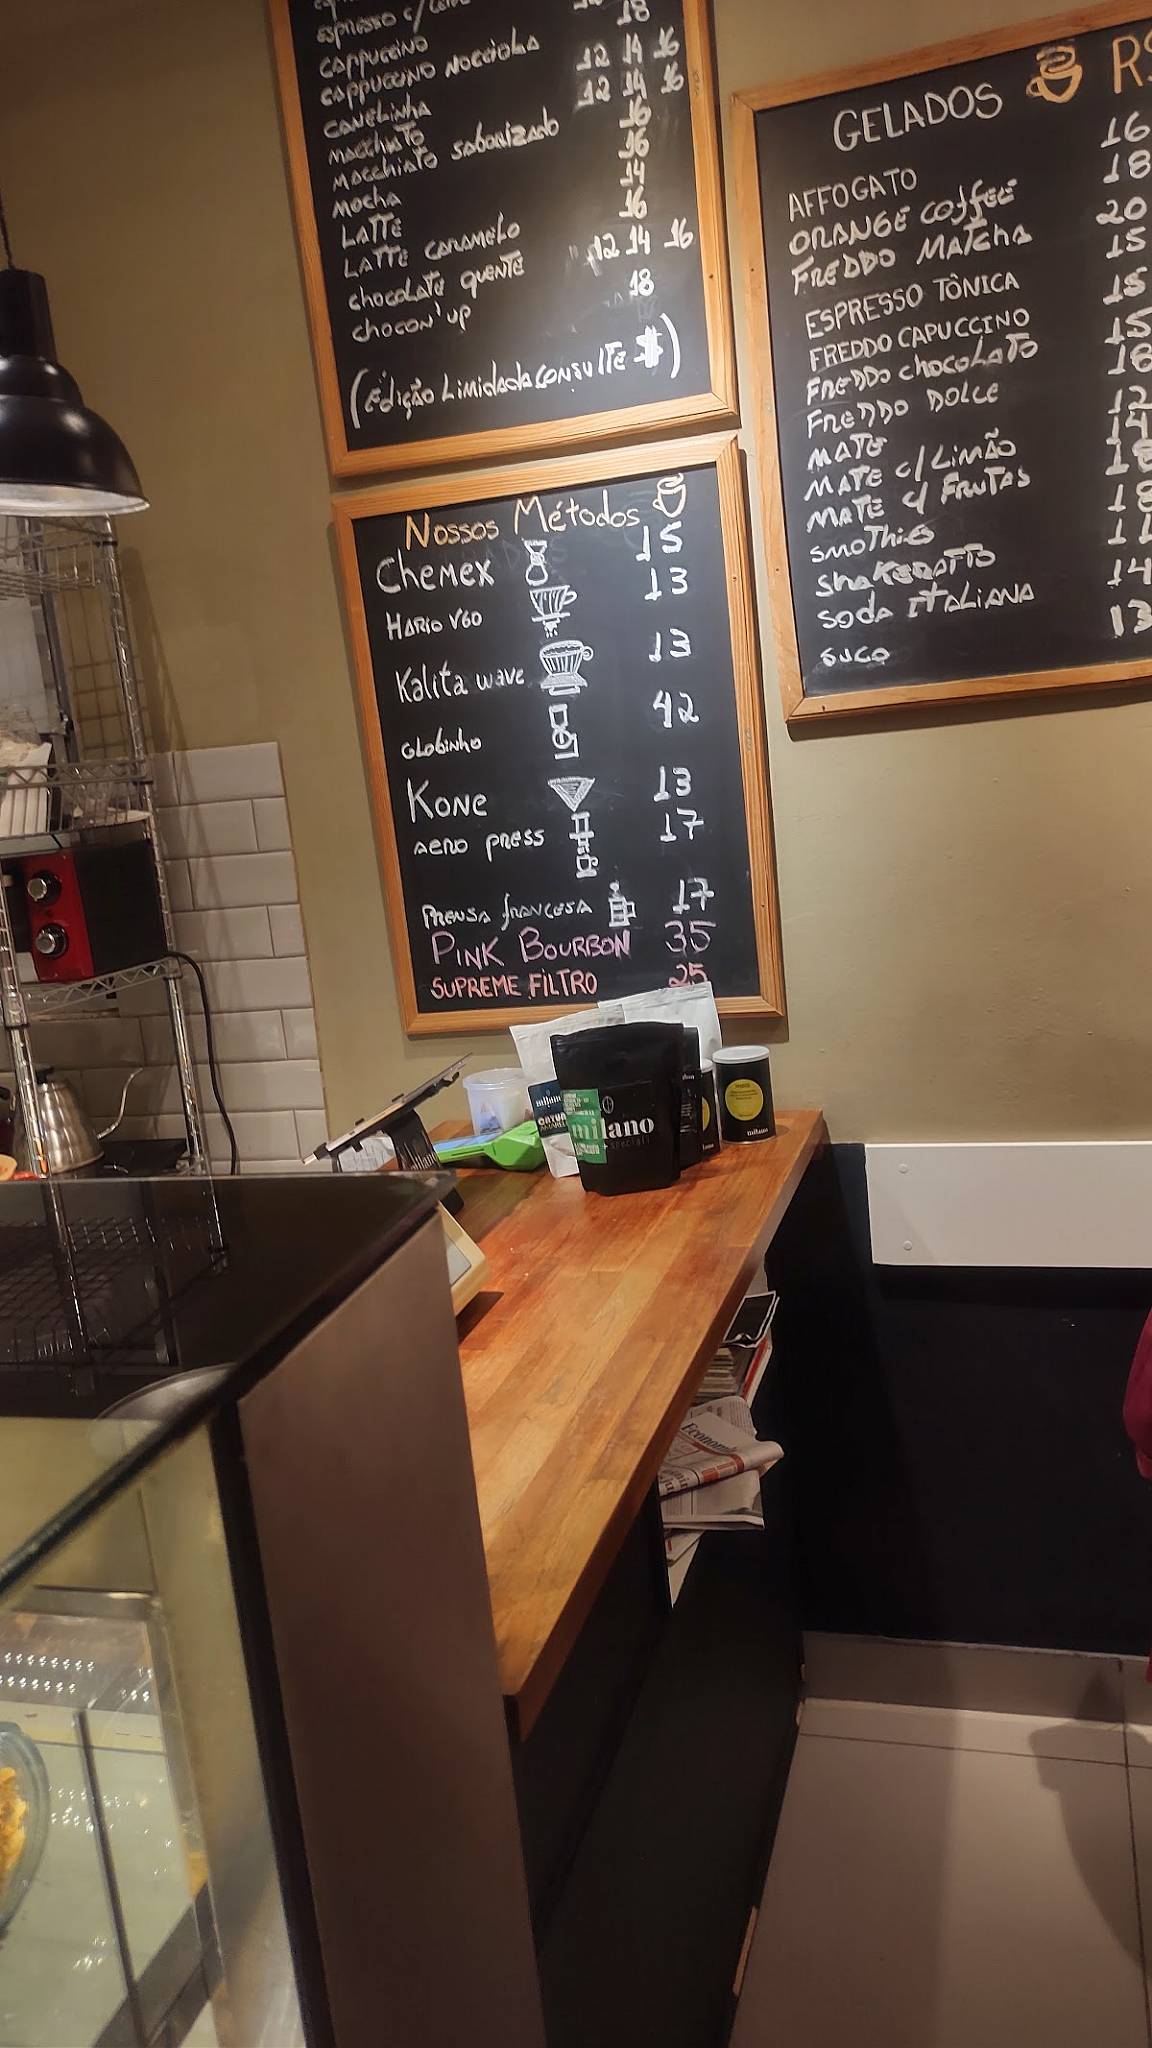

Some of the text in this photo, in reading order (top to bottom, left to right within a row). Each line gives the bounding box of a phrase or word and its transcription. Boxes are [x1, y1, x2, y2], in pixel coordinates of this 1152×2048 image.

[576, 26, 680, 71] 12 14 16
[577, 61, 684, 106] 12 14 16
[619, 96, 651, 128] 16
[833, 82, 1003, 152] GELADOS
[618, 127, 649, 158] 16
[620, 159, 645, 187] 14
[788, 111, 1150, 222] AFFOGATO 16
[1103, 150, 1151, 183] 18
[619, 185, 647, 219] 16
[1096, 196, 1147, 225] 20
[626, 224, 650, 254] 14
[664, 217, 693, 249] 16
[629, 268, 654, 297] 18
[805, 226, 1146, 340] ESPRESSO TÔNICA 15
[809, 266, 1148, 372] FREDDO CAPUCCINO 15
[1104, 306, 1152, 344] 15
[1107, 385, 1152, 415] 12
[803, 464, 883, 501] MATE
[1106, 410, 1149, 445] 14
[514, 489, 641, 535] Métodos
[806, 494, 885, 534] MATE
[636, 522, 684, 561] 15
[1106, 557, 1152, 587] 14
[449, 608, 483, 629] V60
[645, 567, 689, 600] 13
[1109, 599, 1152, 637] 13
[395, 628, 691, 703] Kalita wave 13
[653, 690, 700, 728] 42
[653, 766, 692, 802] 13
[660, 808, 705, 842] 17
[672, 877, 715, 915] 17
[431, 920, 716, 970] PINK BOURBON 35
[430, 971, 521, 1000] SUPREME
[669, 962, 708, 987] 25
